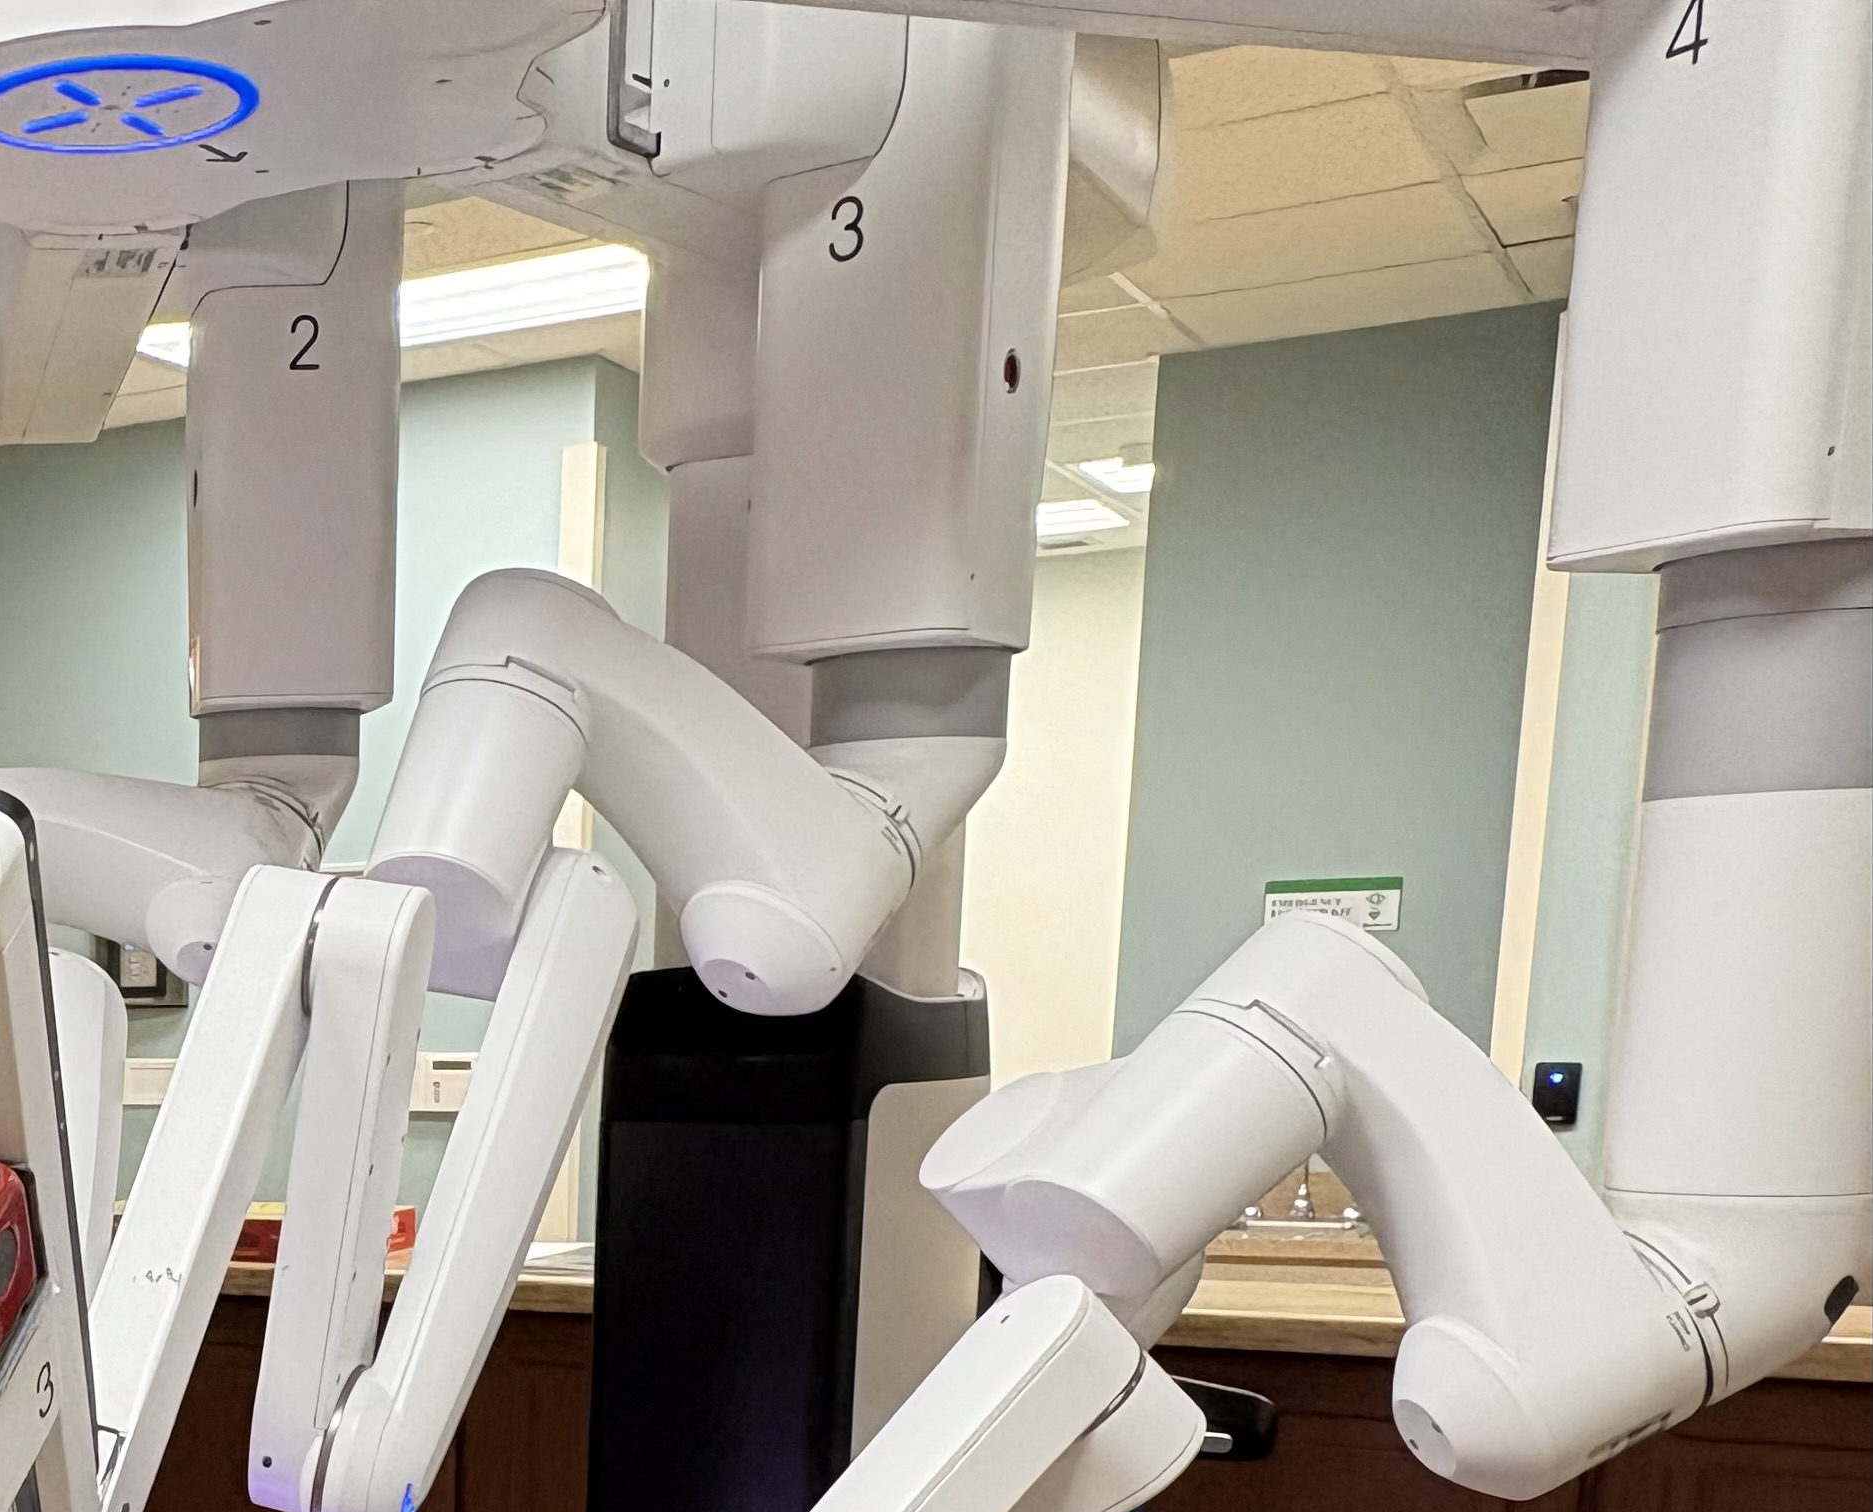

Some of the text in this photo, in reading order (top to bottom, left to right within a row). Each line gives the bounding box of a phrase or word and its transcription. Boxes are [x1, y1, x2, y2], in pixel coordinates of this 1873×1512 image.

[1665, 0, 1709, 65] 4
[828, 195, 864, 263] 3
[289, 314, 320, 371] 2
[36, 1361, 55, 1419] 3
